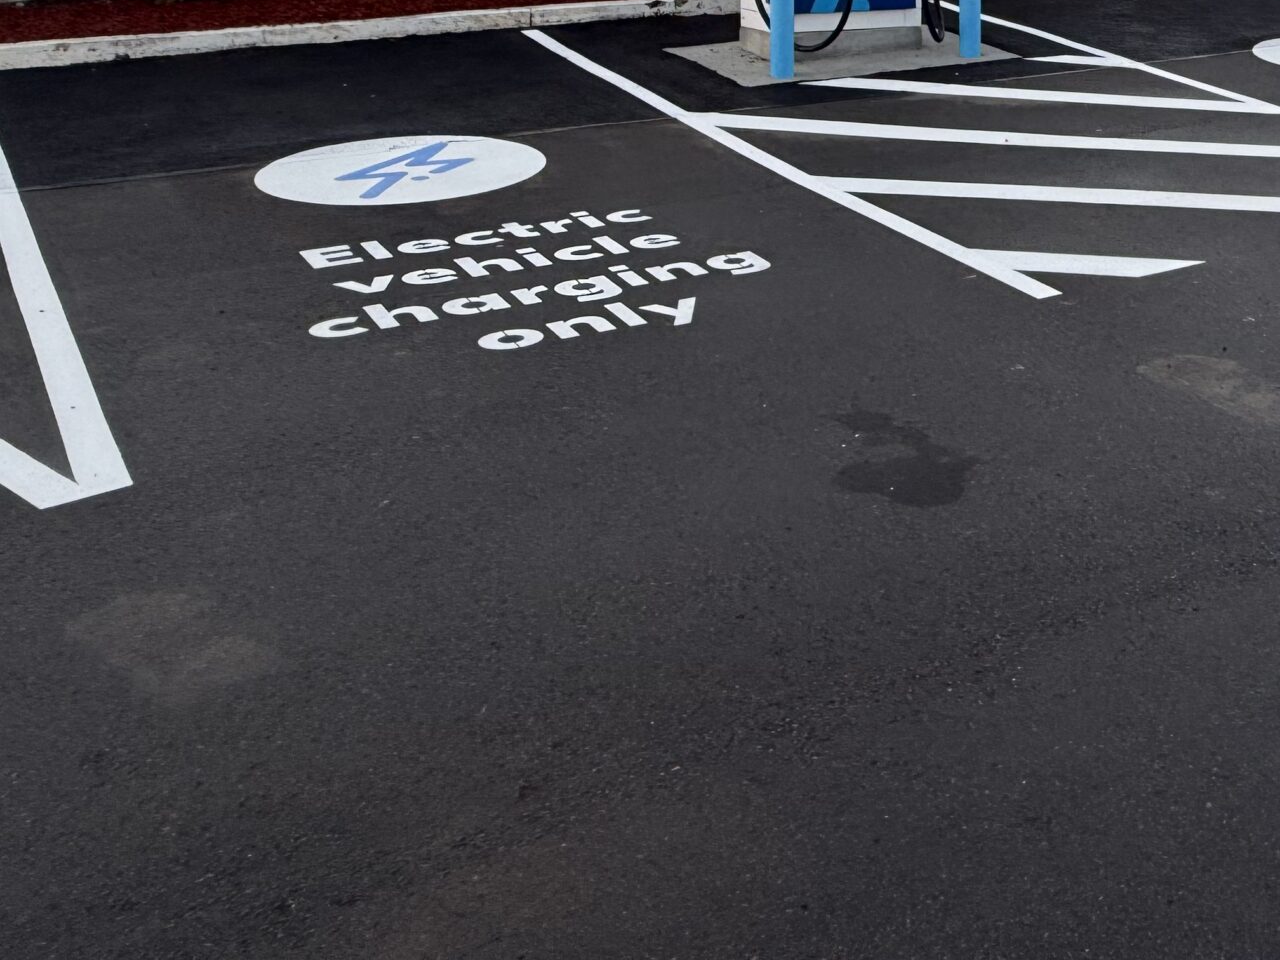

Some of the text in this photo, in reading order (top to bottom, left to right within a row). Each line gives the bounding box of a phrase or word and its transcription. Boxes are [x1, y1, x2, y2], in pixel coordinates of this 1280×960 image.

[299, 208, 654, 270] Electric
[333, 230, 681, 295] vehicle
[308, 246, 772, 338] charging
[478, 296, 697, 350] only
